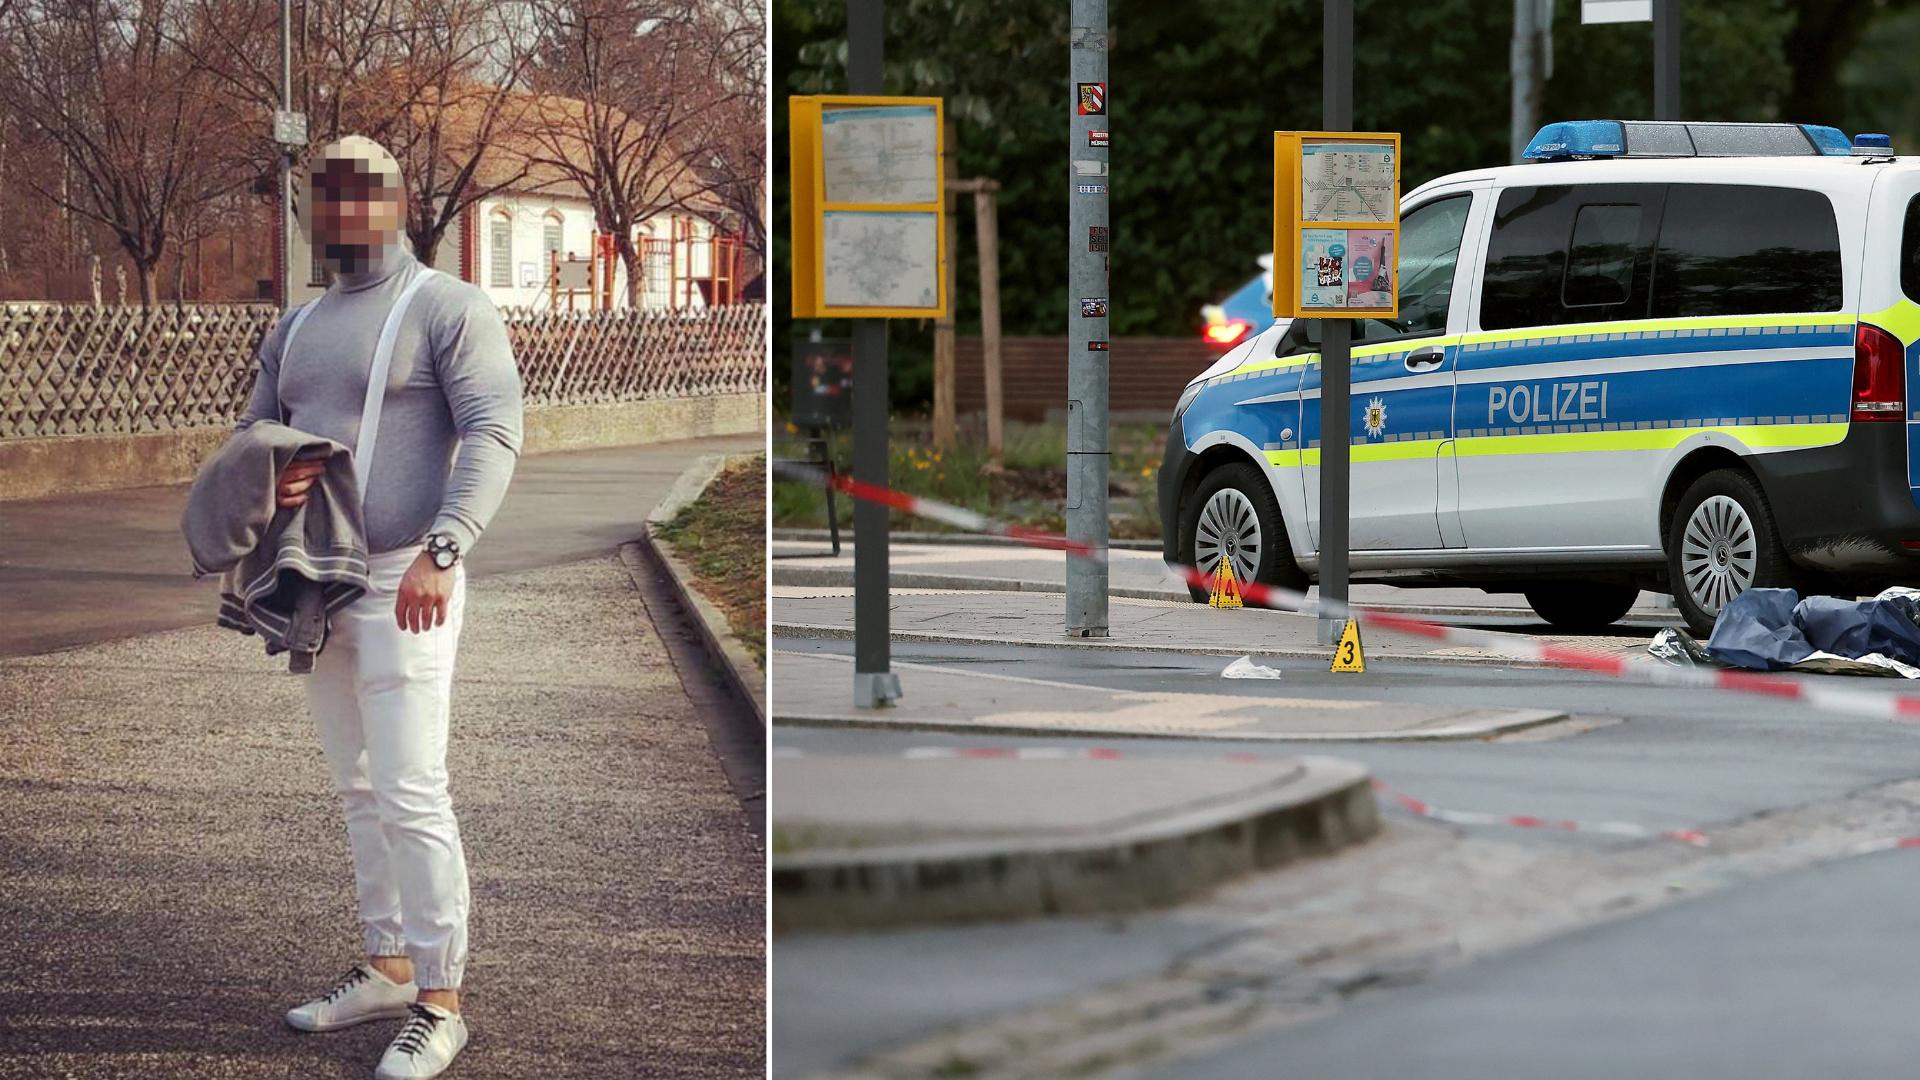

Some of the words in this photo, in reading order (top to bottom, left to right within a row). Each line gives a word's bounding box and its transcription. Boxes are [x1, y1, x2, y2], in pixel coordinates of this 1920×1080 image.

[1488, 381, 1608, 424] POLIZEI
[1224, 578, 1235, 601] 4
[1342, 640, 1355, 665] 3
